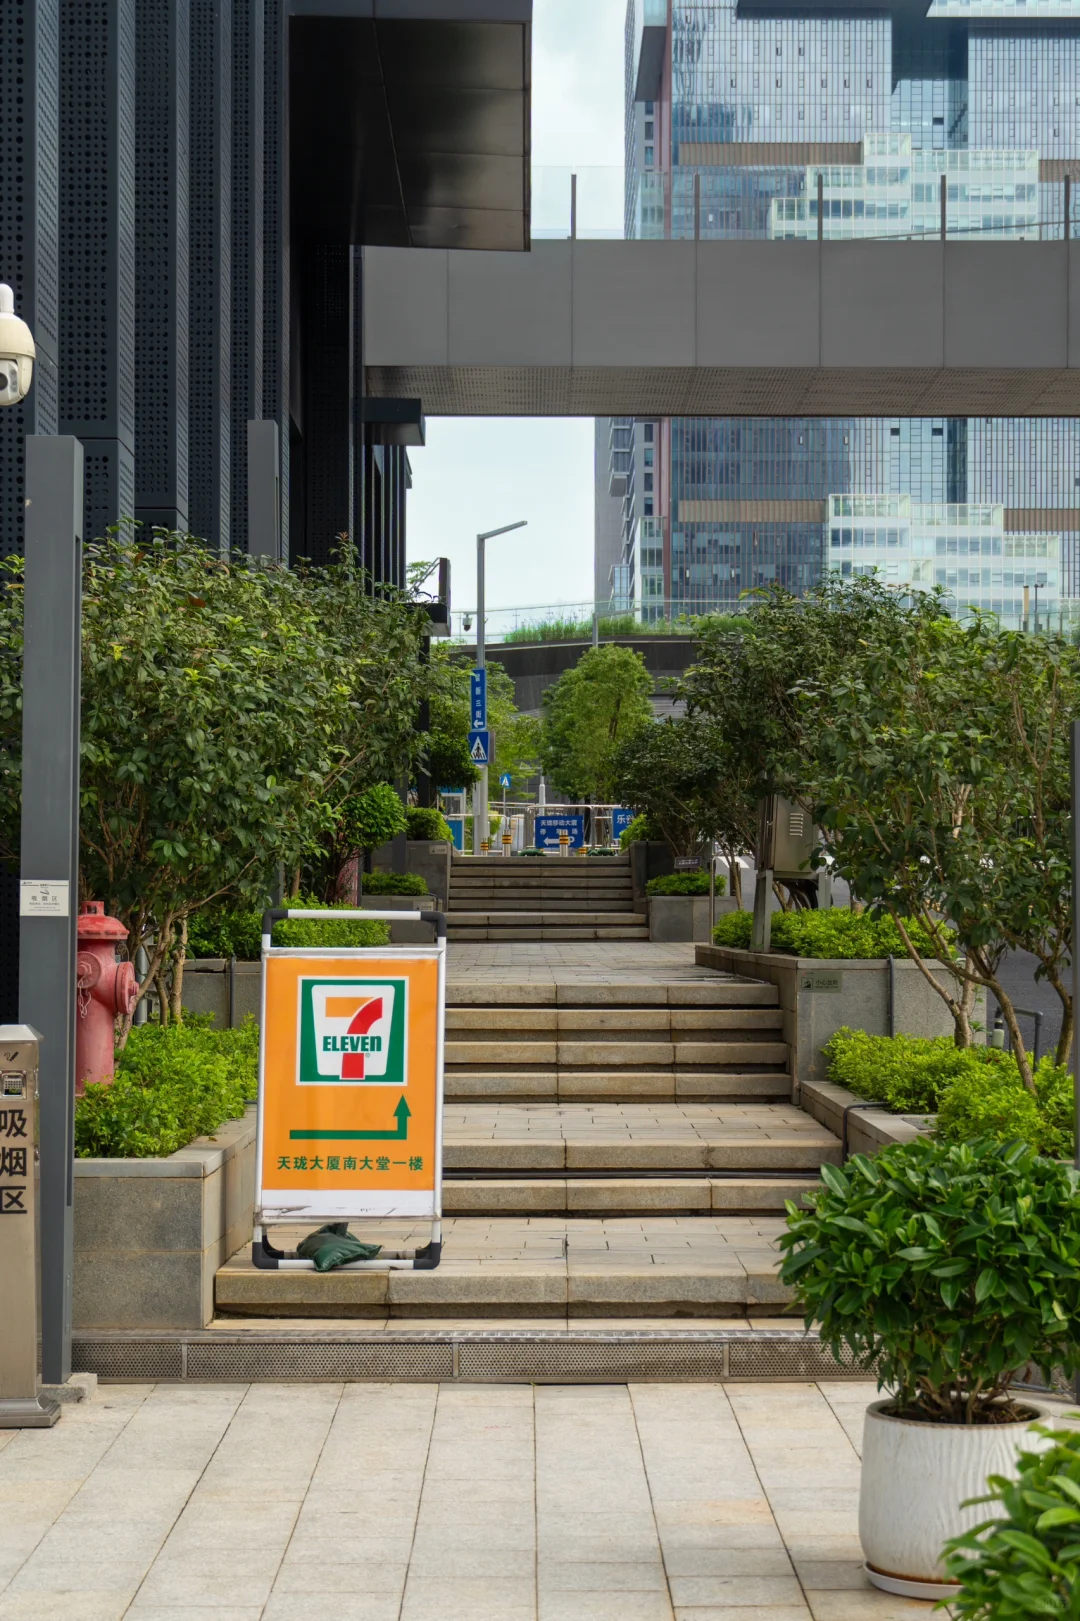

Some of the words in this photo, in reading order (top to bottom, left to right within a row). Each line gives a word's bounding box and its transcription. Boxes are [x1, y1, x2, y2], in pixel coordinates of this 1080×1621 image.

[325, 997, 383, 1079] 7
[0, 1109, 28, 1214] 吸烟区
[277, 1156, 424, 1171] 天珑大厦南大堂一楼
